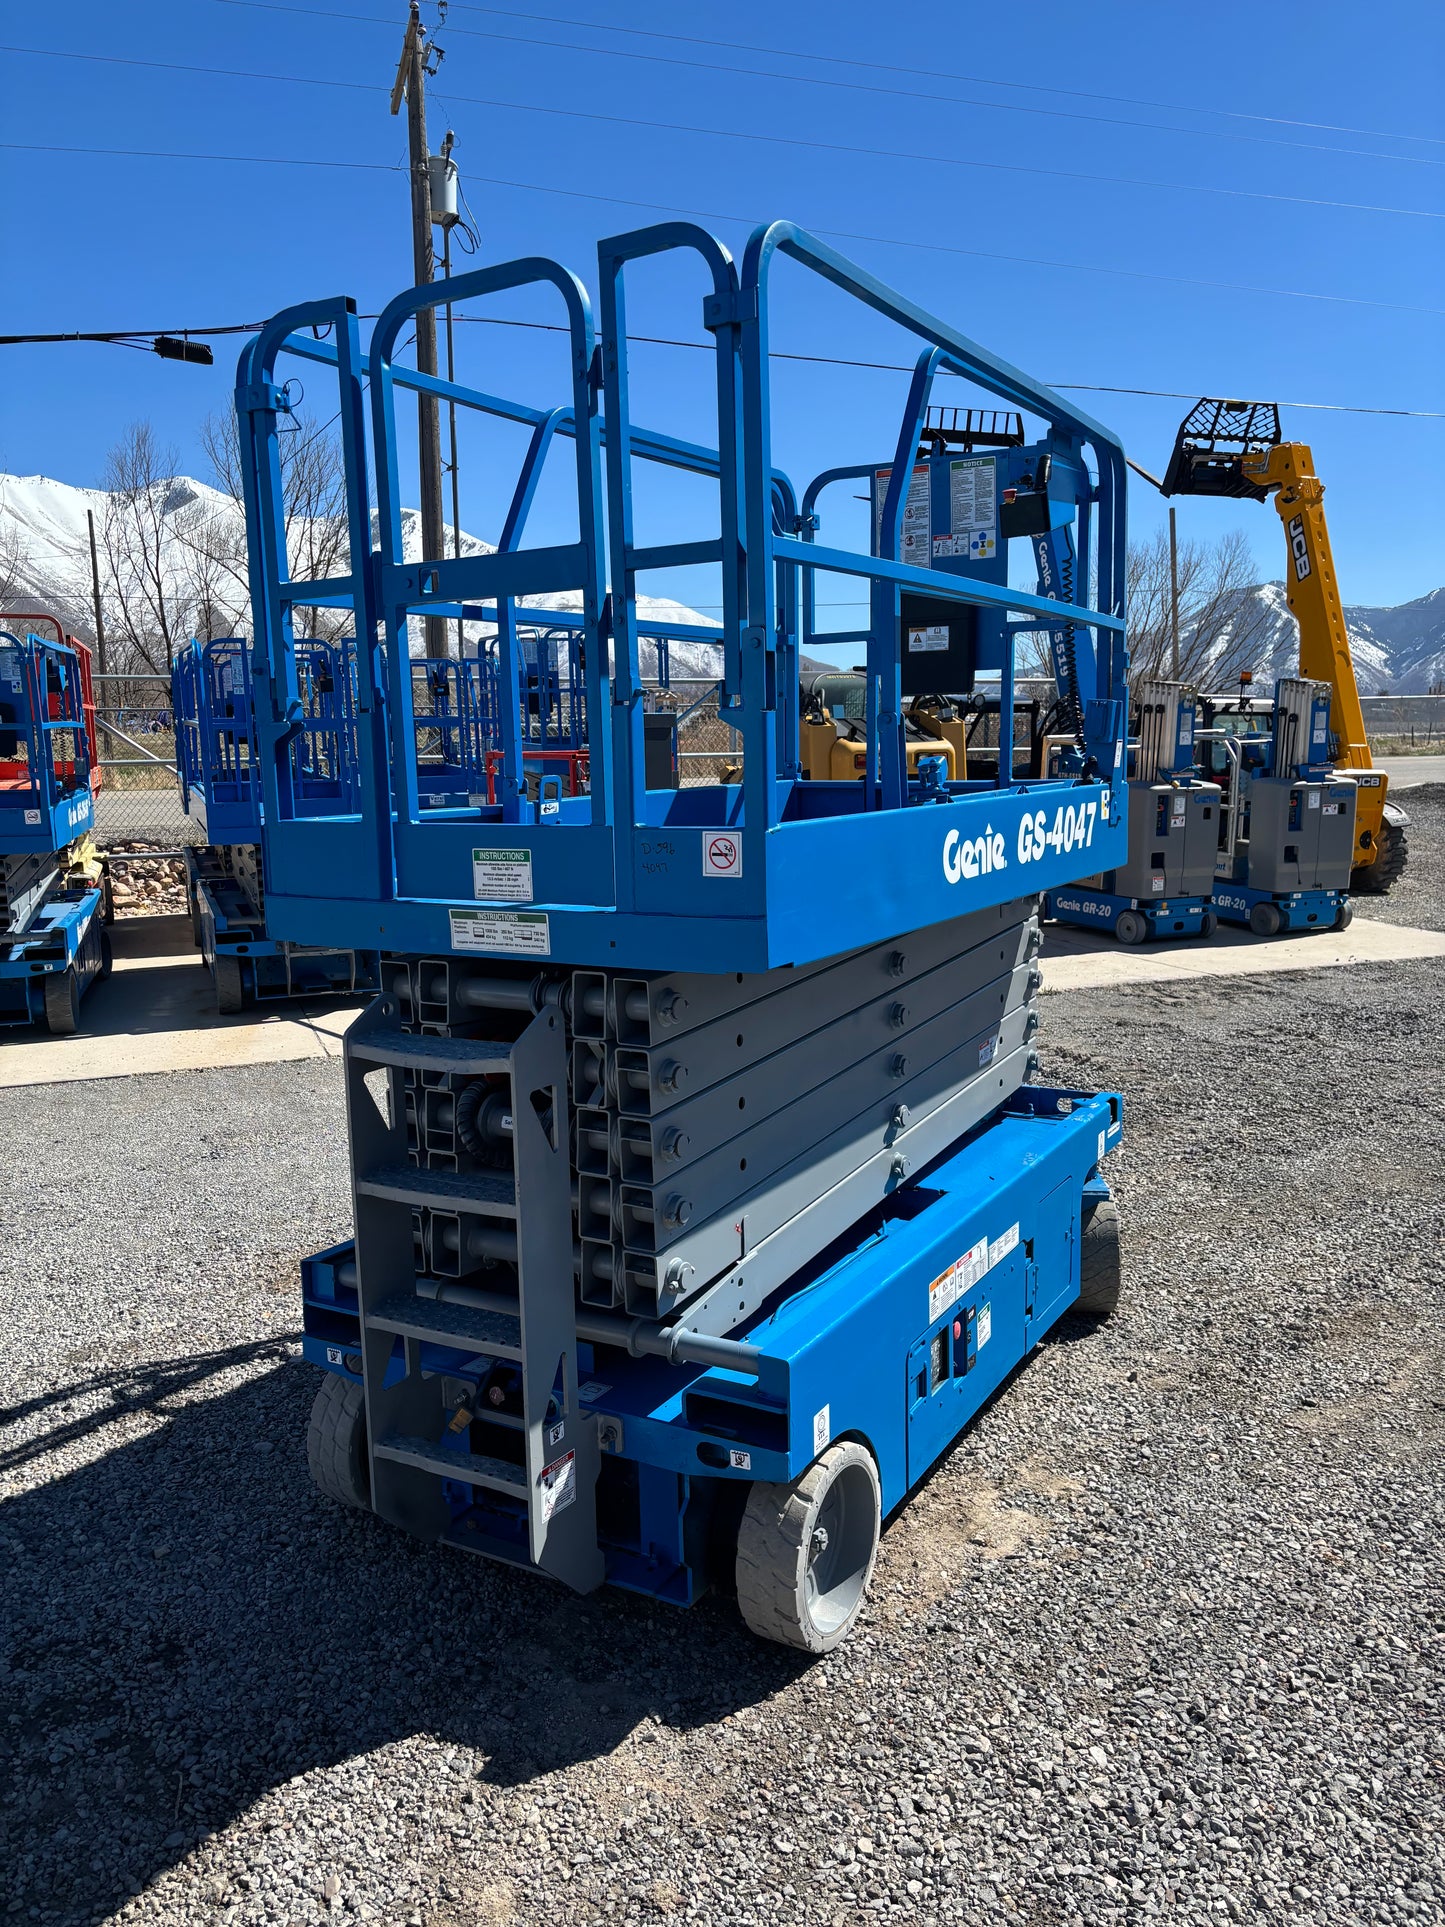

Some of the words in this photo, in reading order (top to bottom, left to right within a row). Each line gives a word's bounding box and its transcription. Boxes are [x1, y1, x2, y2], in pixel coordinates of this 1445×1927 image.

[1289, 519, 1310, 580] JCB
[1039, 542, 1051, 587] Genie
[1358, 777, 1380, 786] JCB
[1194, 792, 1220, 804] Genie
[943, 823, 1006, 884] Genie
[1018, 801, 1096, 864] GS-4047
[479, 851, 525, 861] INSTRUCTIONS
[1056, 897, 1081, 911] Genie
[1082, 901, 1111, 917] GR-20
[1218, 895, 1246, 910] GR-20
[477, 912, 519, 922] INSTRUCTIONS
